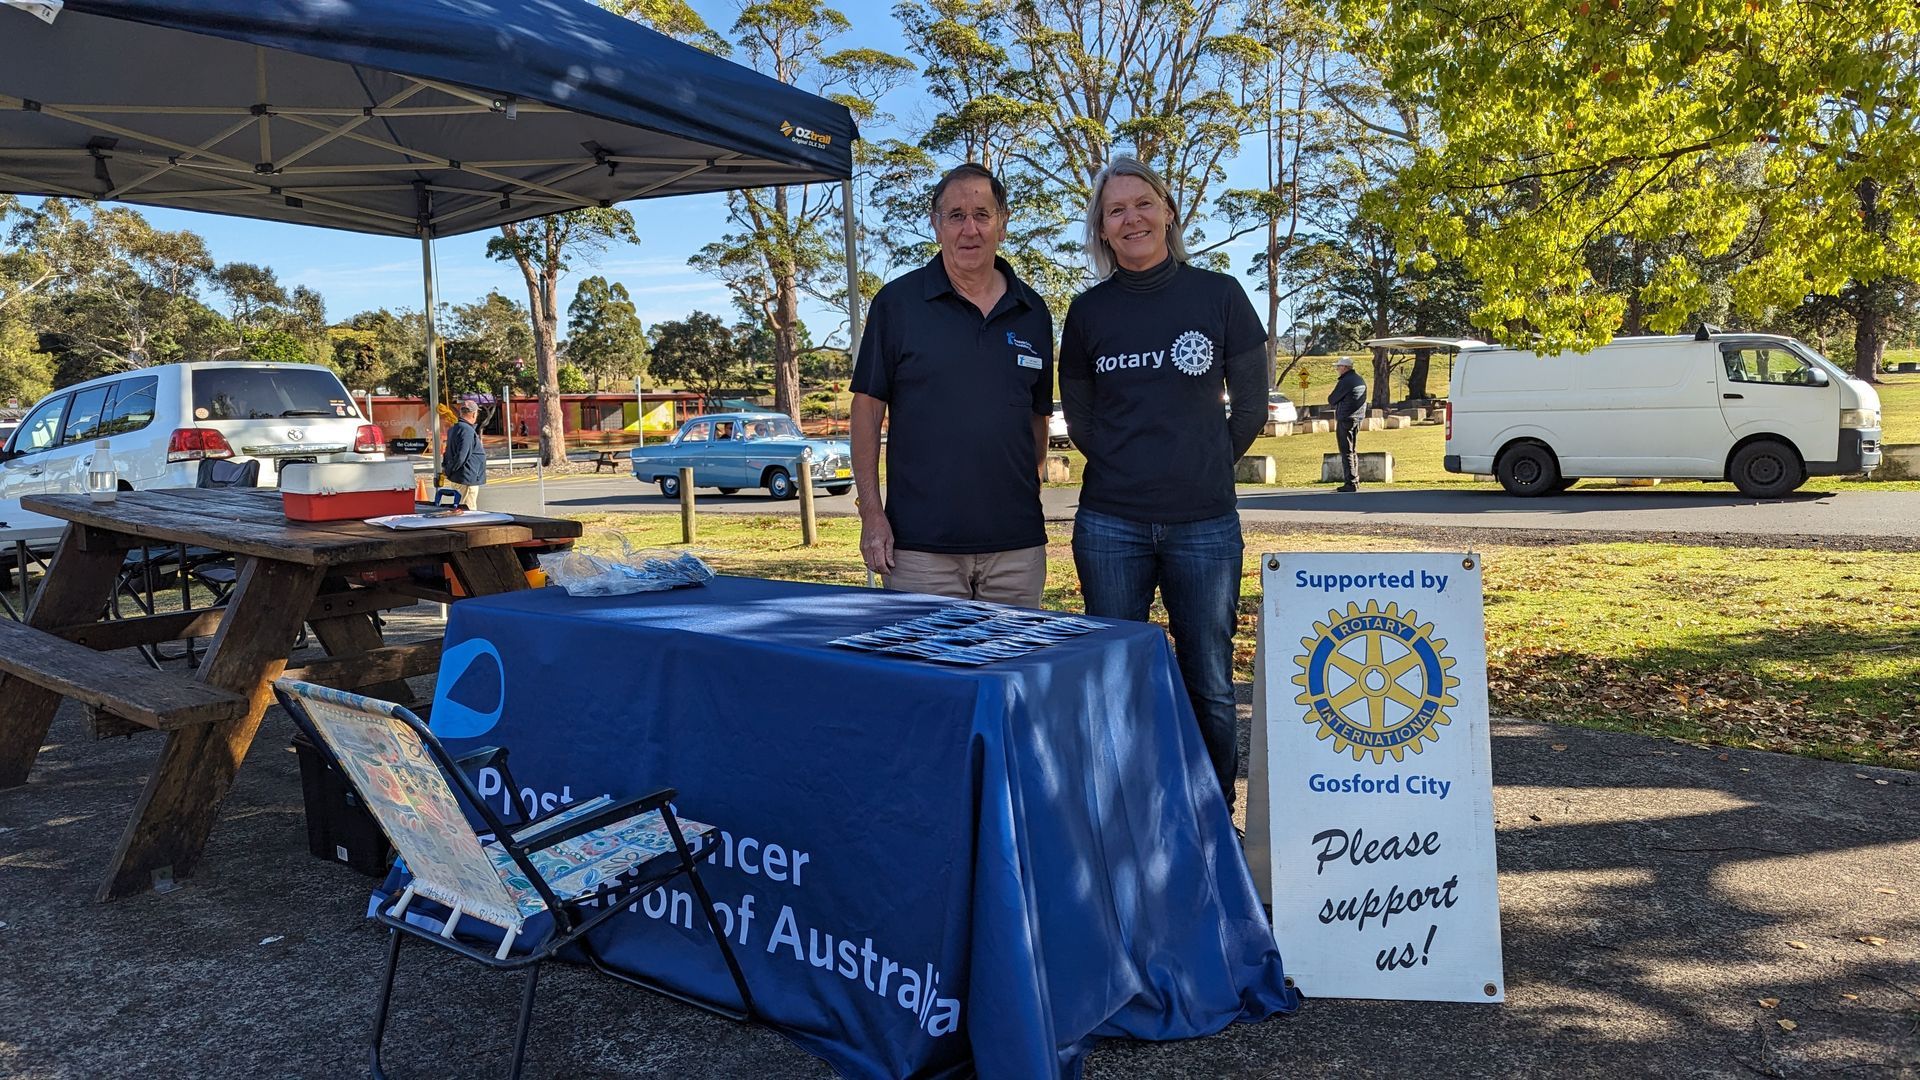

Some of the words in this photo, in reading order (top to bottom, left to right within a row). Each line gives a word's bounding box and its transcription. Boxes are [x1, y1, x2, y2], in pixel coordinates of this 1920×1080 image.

[1096, 350, 1165, 374] Rotary
[1295, 569, 1415, 592] Supported
[1421, 569, 1448, 593] by
[1340, 617, 1409, 637] ROTARY
[1320, 706, 1436, 747] INTERNATIONAL
[1309, 773, 1399, 794] Gosford
[1406, 775, 1451, 800] City
[1311, 828, 1441, 875] Please
[1318, 874, 1459, 932] support
[707, 894, 755, 945] of
[767, 904, 960, 1038] Australia
[1375, 924, 1438, 972] us!
